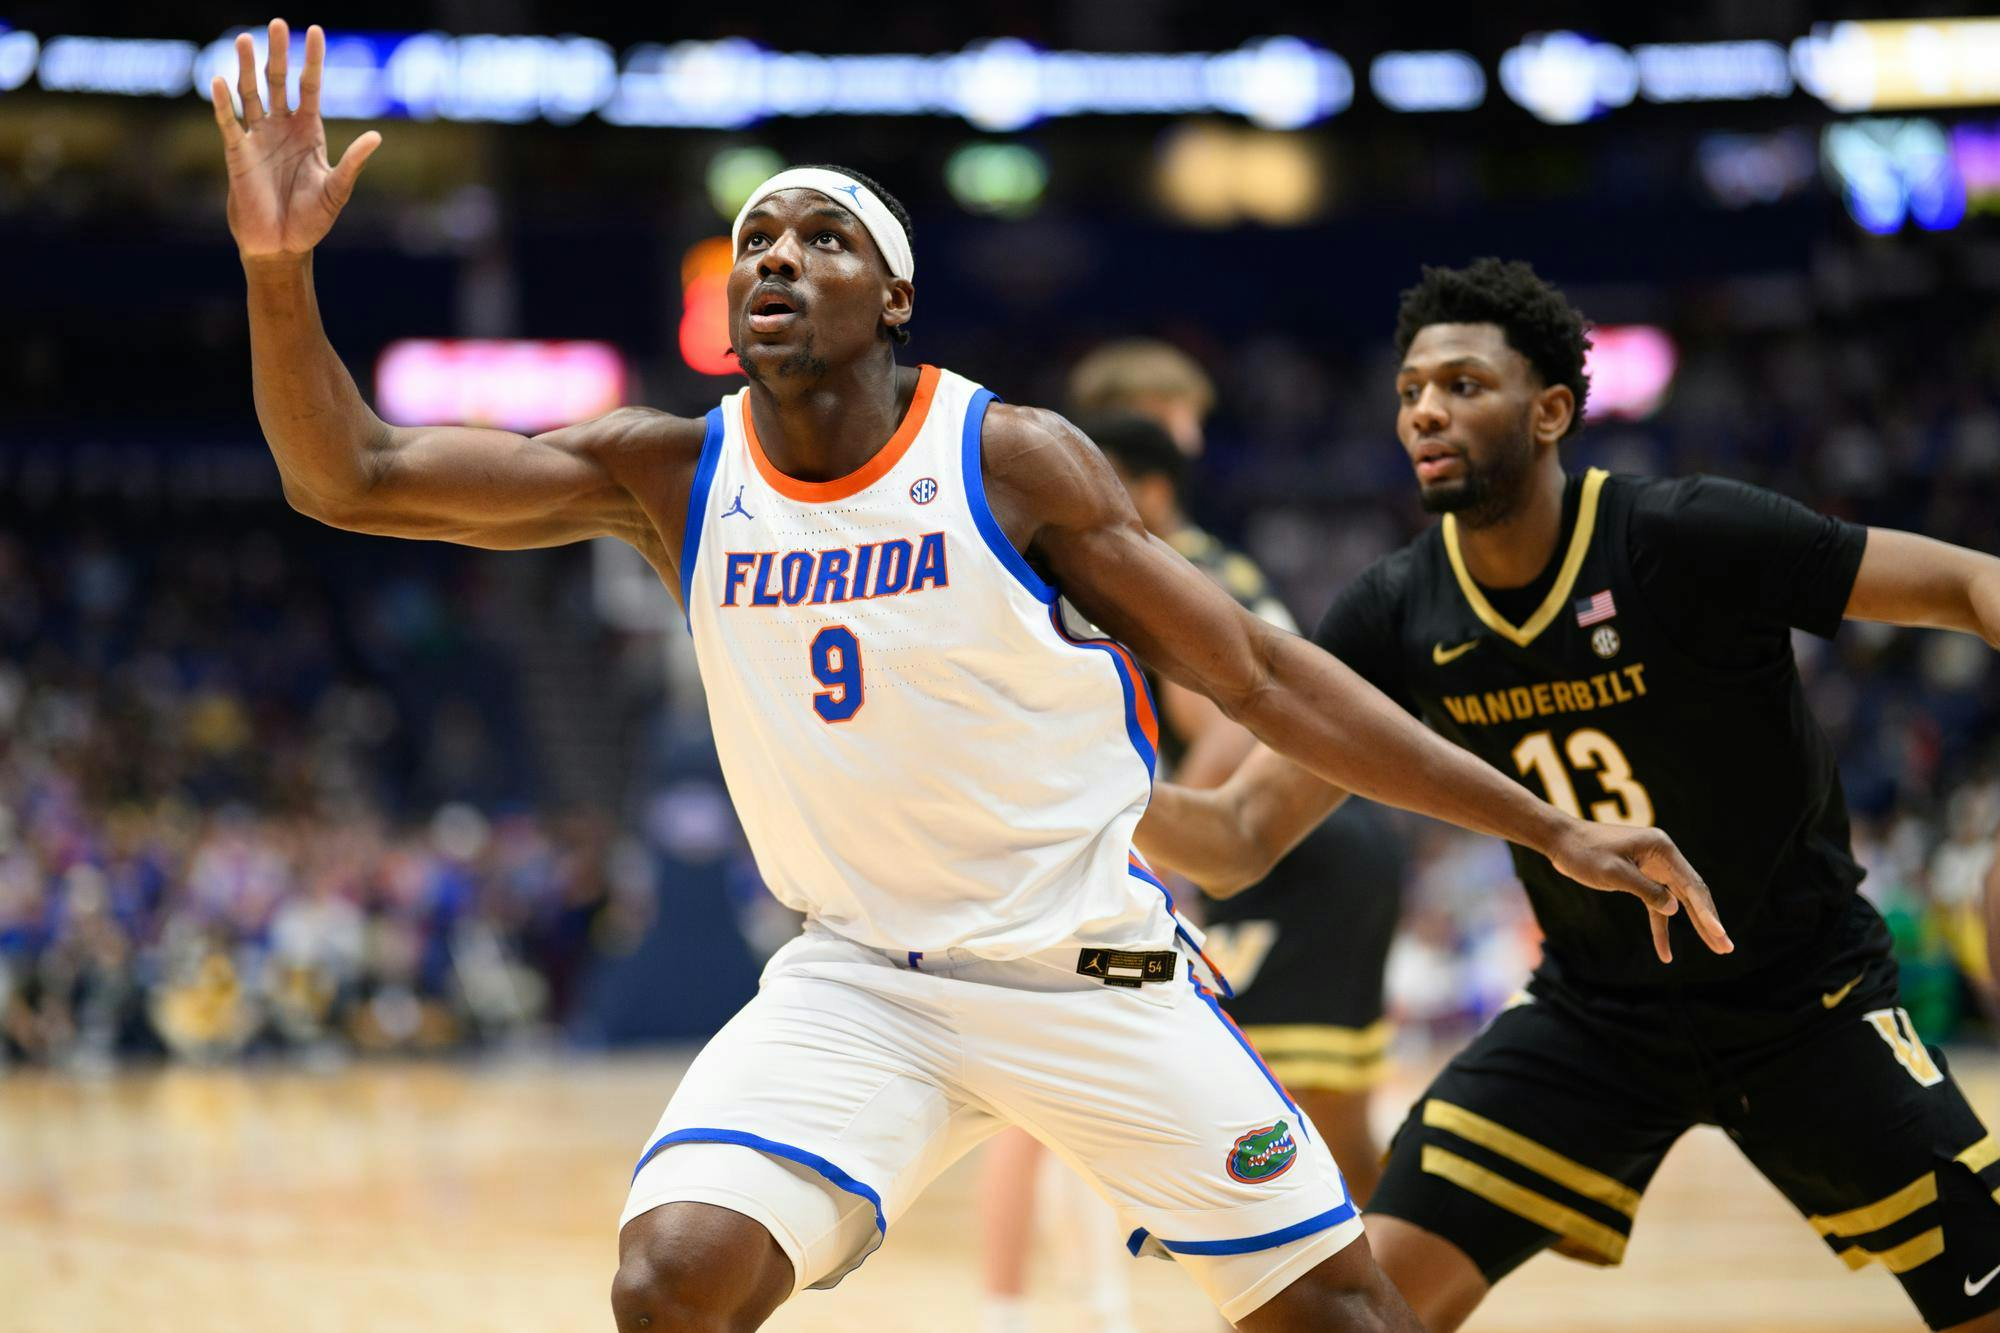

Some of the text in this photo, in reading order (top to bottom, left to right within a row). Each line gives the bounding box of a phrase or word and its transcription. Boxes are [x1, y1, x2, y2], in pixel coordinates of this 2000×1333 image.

[911, 478, 938, 504] SEC
[720, 531, 949, 607] FLORIDA
[809, 624, 865, 724] 9
[1443, 663, 1647, 725] VANDERBILT
[1511, 727, 1655, 828] 13
[1147, 960, 1162, 974] 54
